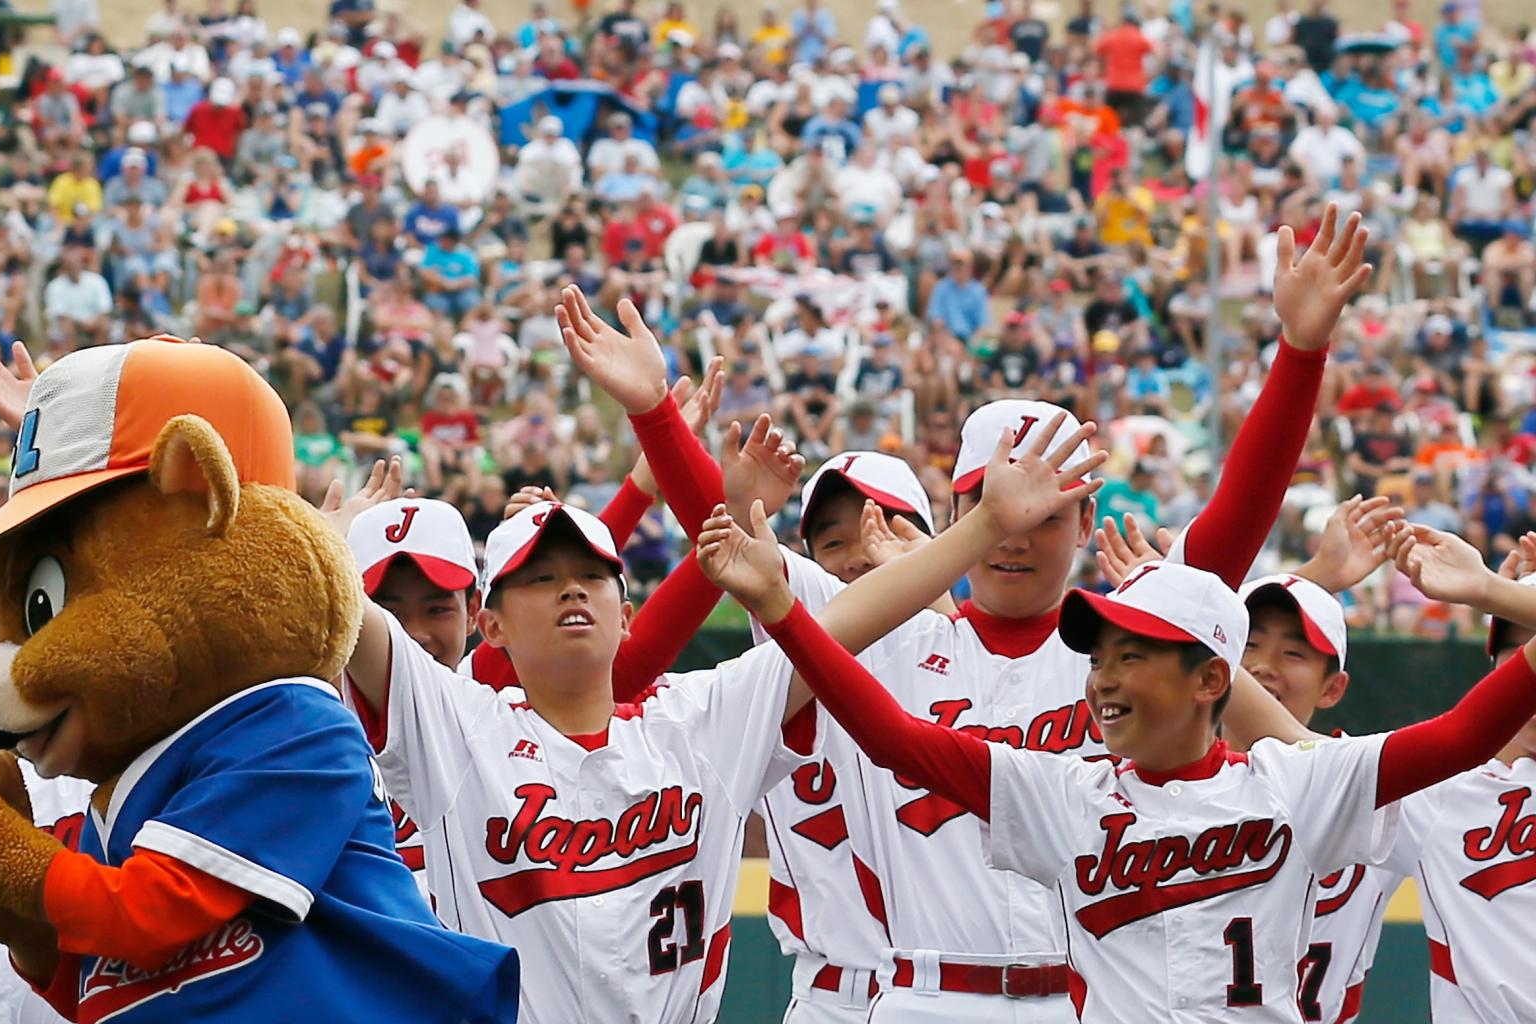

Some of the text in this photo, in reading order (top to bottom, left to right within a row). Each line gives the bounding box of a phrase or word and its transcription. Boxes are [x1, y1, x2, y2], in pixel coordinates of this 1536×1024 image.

[385, 506, 419, 543] J
[485, 783, 704, 872] Japan
[1074, 811, 1292, 896] Japan
[647, 879, 706, 977] 21
[1222, 916, 1263, 1007] 1
